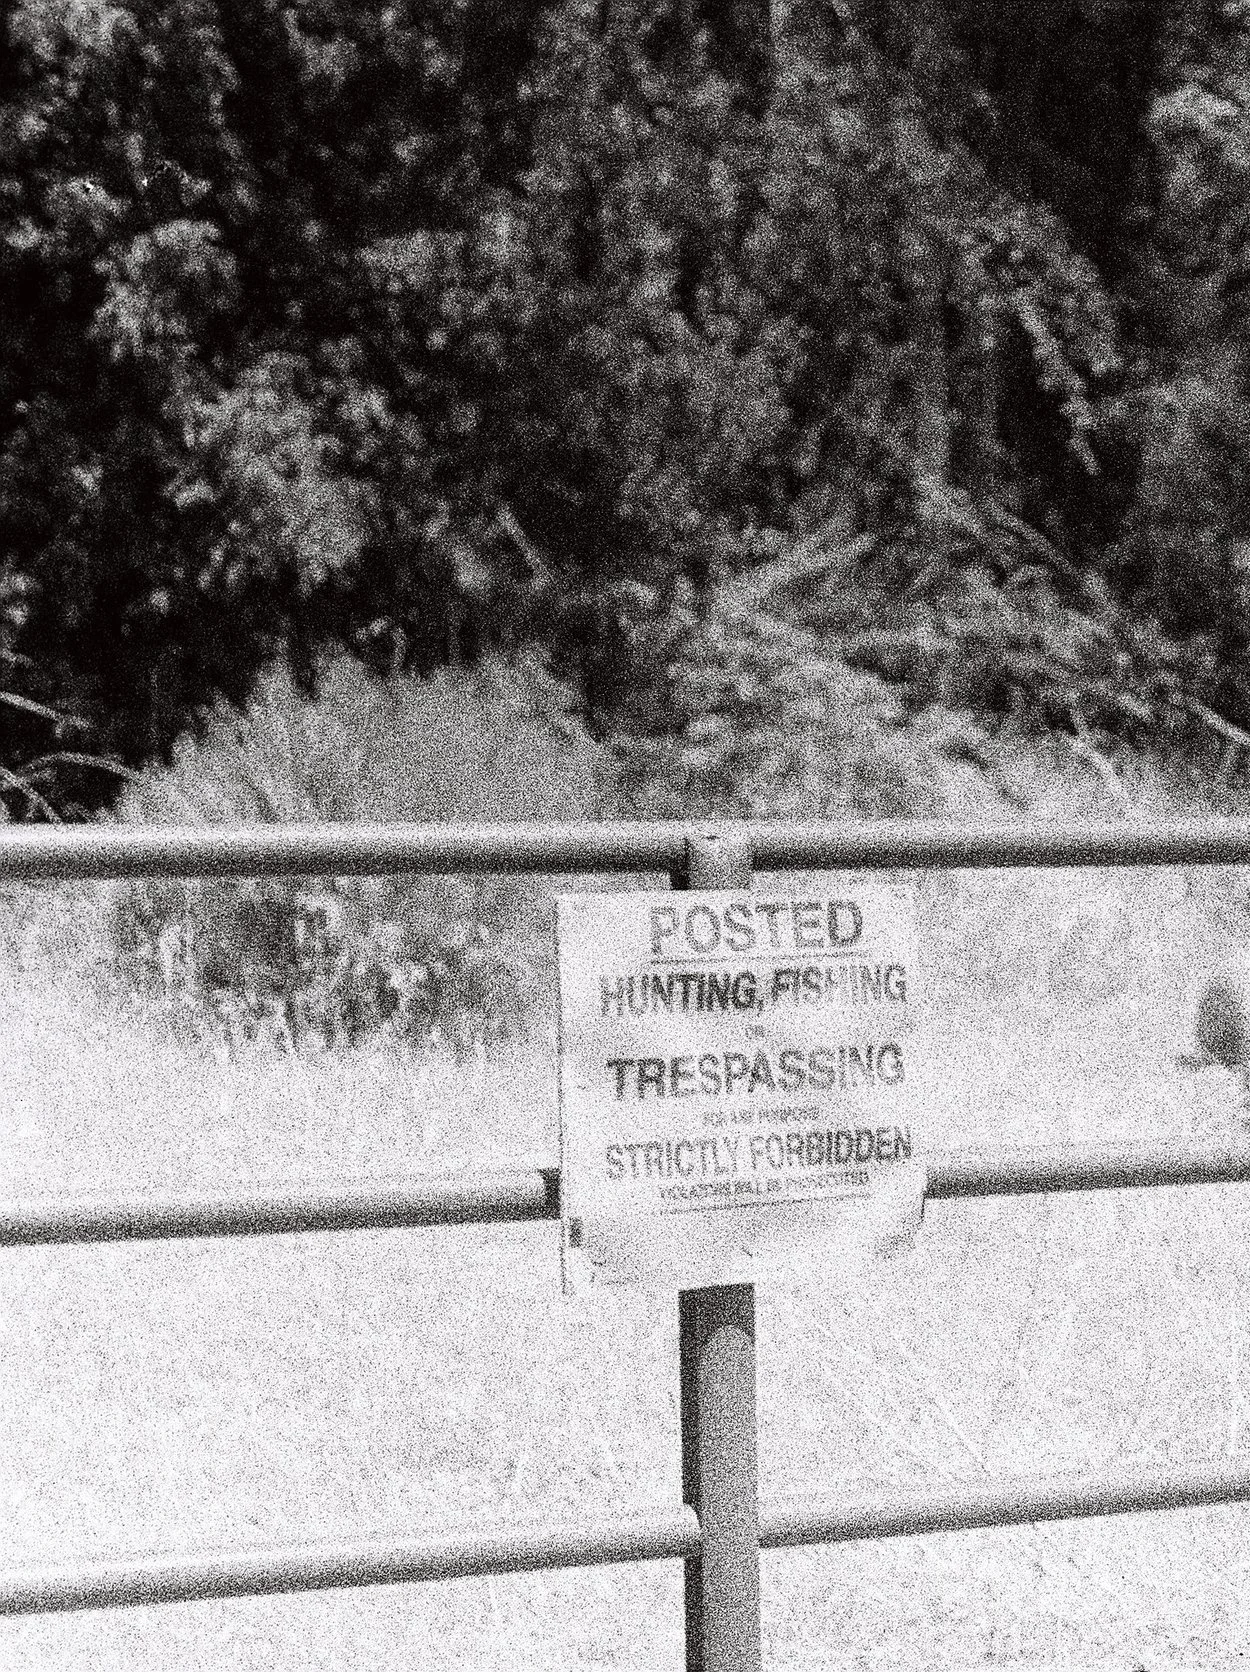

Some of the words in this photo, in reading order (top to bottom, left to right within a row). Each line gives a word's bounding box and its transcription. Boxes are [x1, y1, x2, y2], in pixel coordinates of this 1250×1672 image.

[650, 901, 863, 954] POSTED
[600, 972, 764, 1016] HUNTING,
[770, 965, 907, 1005] FISHING
[607, 1043, 904, 1100] TRESPASSING
[606, 1136, 740, 1179] STRICTLY
[750, 1126, 912, 1168] FORBIDDEN
